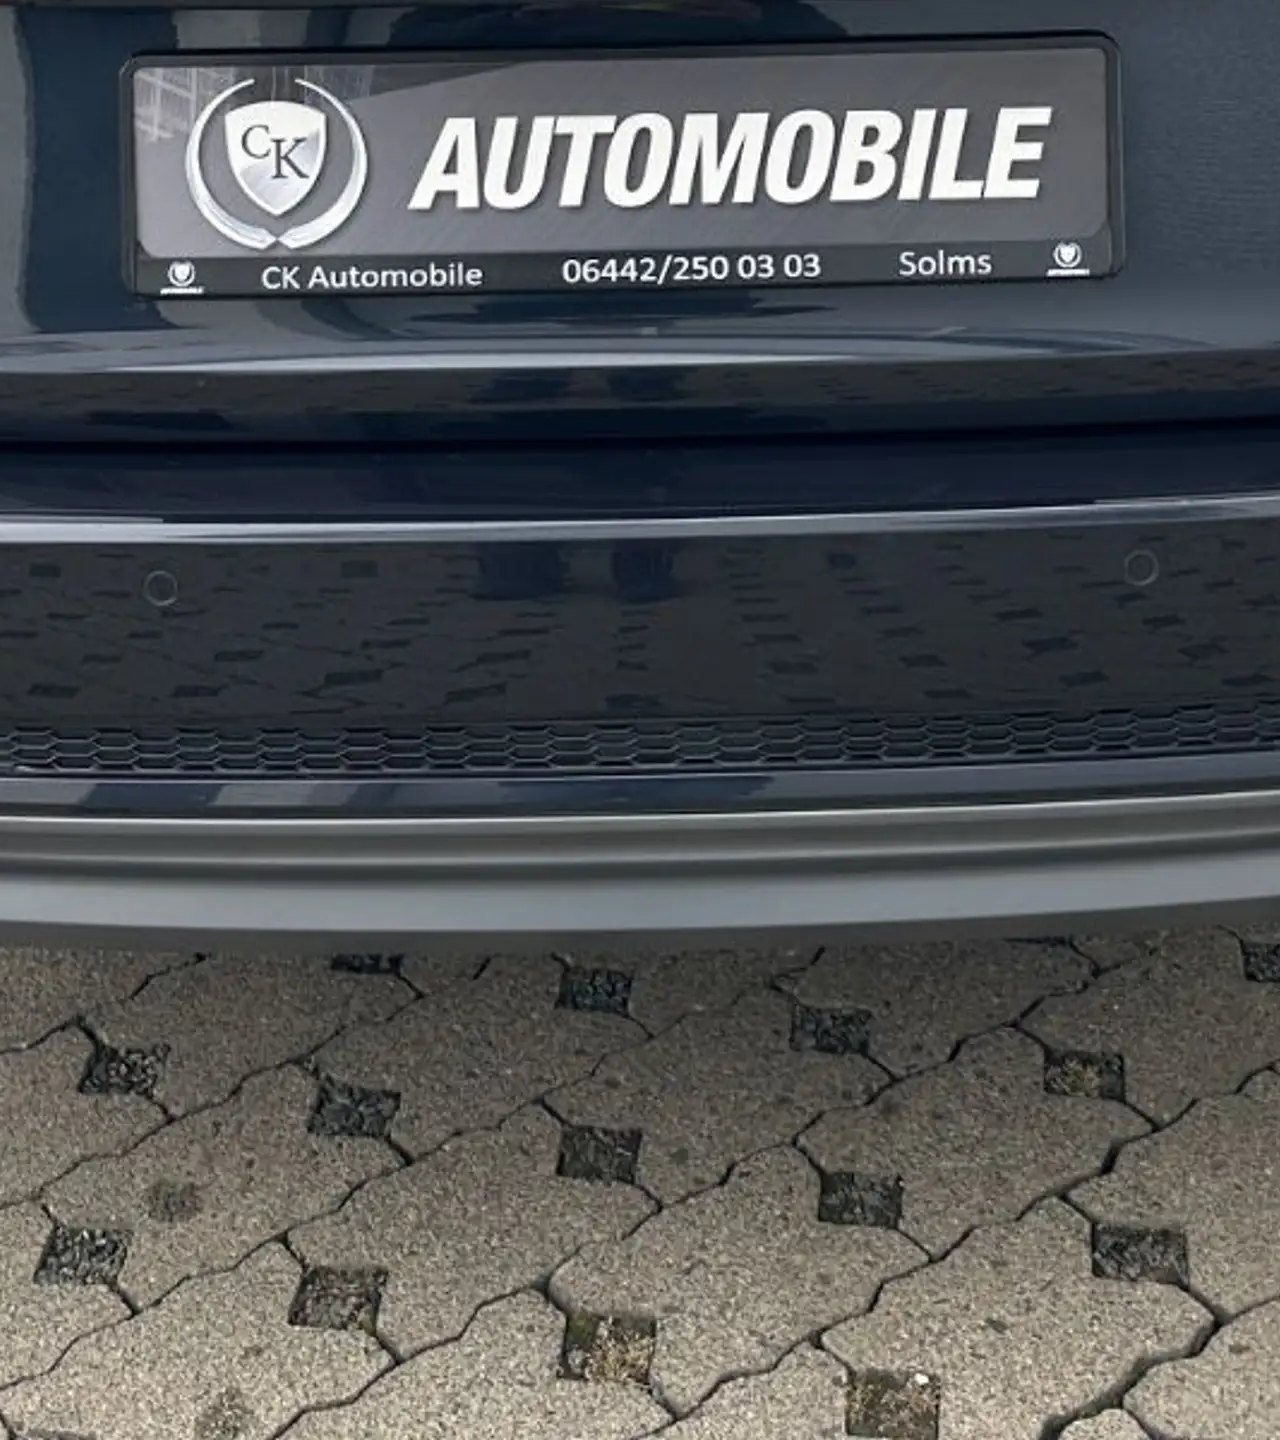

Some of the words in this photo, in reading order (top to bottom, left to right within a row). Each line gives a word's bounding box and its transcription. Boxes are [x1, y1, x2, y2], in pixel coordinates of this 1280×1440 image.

[241, 124, 309, 179] CK
[407, 106, 1053, 210] AUTOMOBILE
[261, 265, 301, 290] CK
[307, 262, 483, 289] Automobile
[561, 254, 730, 285] 06442/250
[736, 254, 775, 279] 03
[783, 253, 821, 278] 03
[899, 249, 993, 276] Solms
